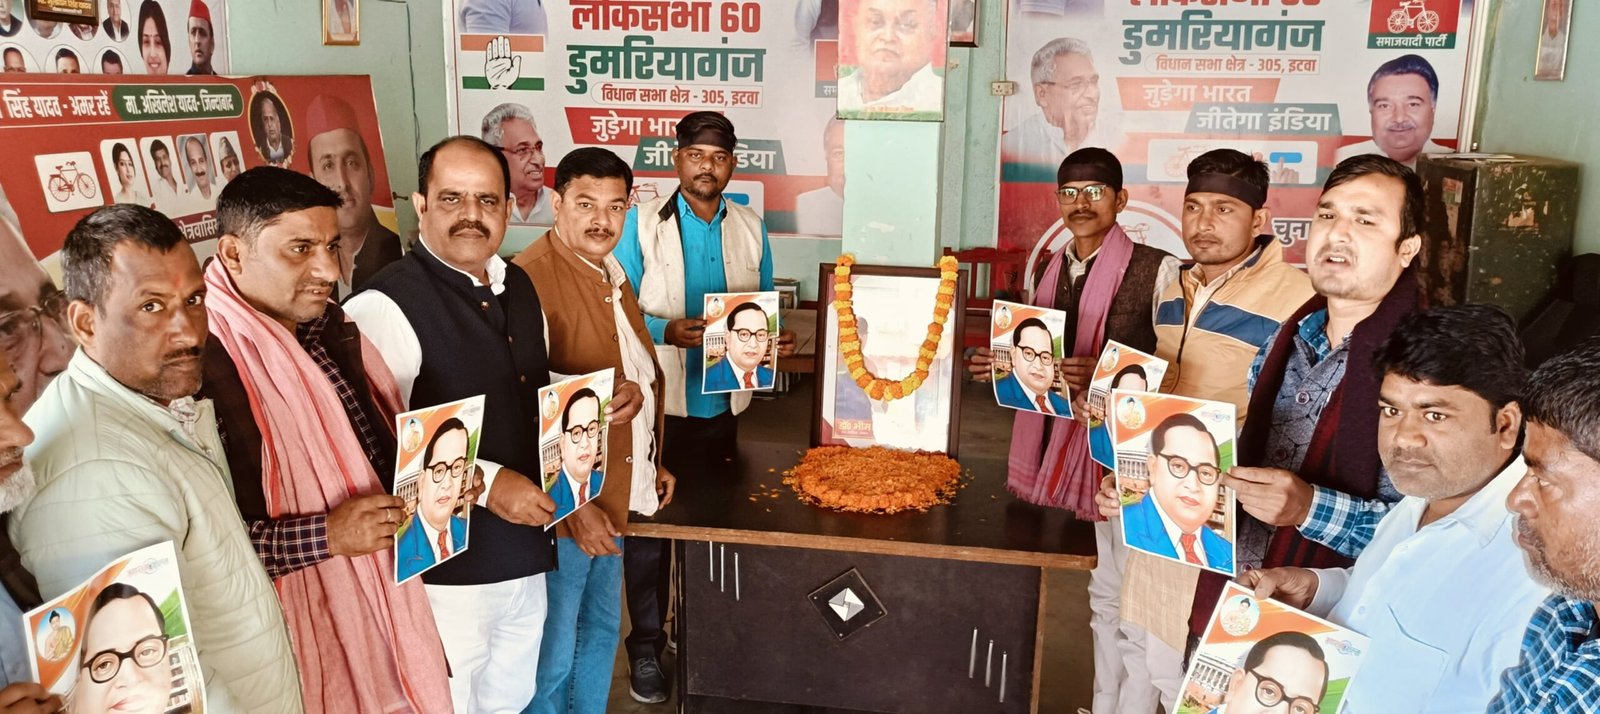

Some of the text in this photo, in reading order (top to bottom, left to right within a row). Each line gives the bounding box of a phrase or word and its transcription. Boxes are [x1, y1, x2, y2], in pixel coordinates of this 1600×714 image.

[720, 2, 761, 33] 60
[1118, 9, 1326, 65] डुमरियागंज
[1376, 33, 1448, 47] समाजवादी पार्टी
[565, 35, 766, 95] डुमरियागंज
[1156, 54, 1192, 71] विधान
[1195, 58, 1223, 71] सभा
[1225, 55, 1247, 72] क्षेत्र
[1258, 58, 1285, 74] 305,
[1288, 59, 1317, 73] इटवा
[2, 88, 33, 118] सिंह
[29, 95, 63, 118] यादव
[68, 95, 97, 116] अमर
[94, 89, 112, 116] रहें
[122, 95, 142, 115] मा.
[140, 89, 178, 114] अखिलेश
[601, 84, 637, 102] विधान
[639, 88, 667, 103] सभा
[670, 86, 690, 103] क्षेत्र
[701, 90, 728, 107] 305,
[731, 90, 760, 106] इटवा
[1142, 79, 1253, 107] जुड़ेगा भारत
[590, 110, 643, 142] जुड़ेगा
[1196, 106, 1332, 132] जीतेगा इंडिया
